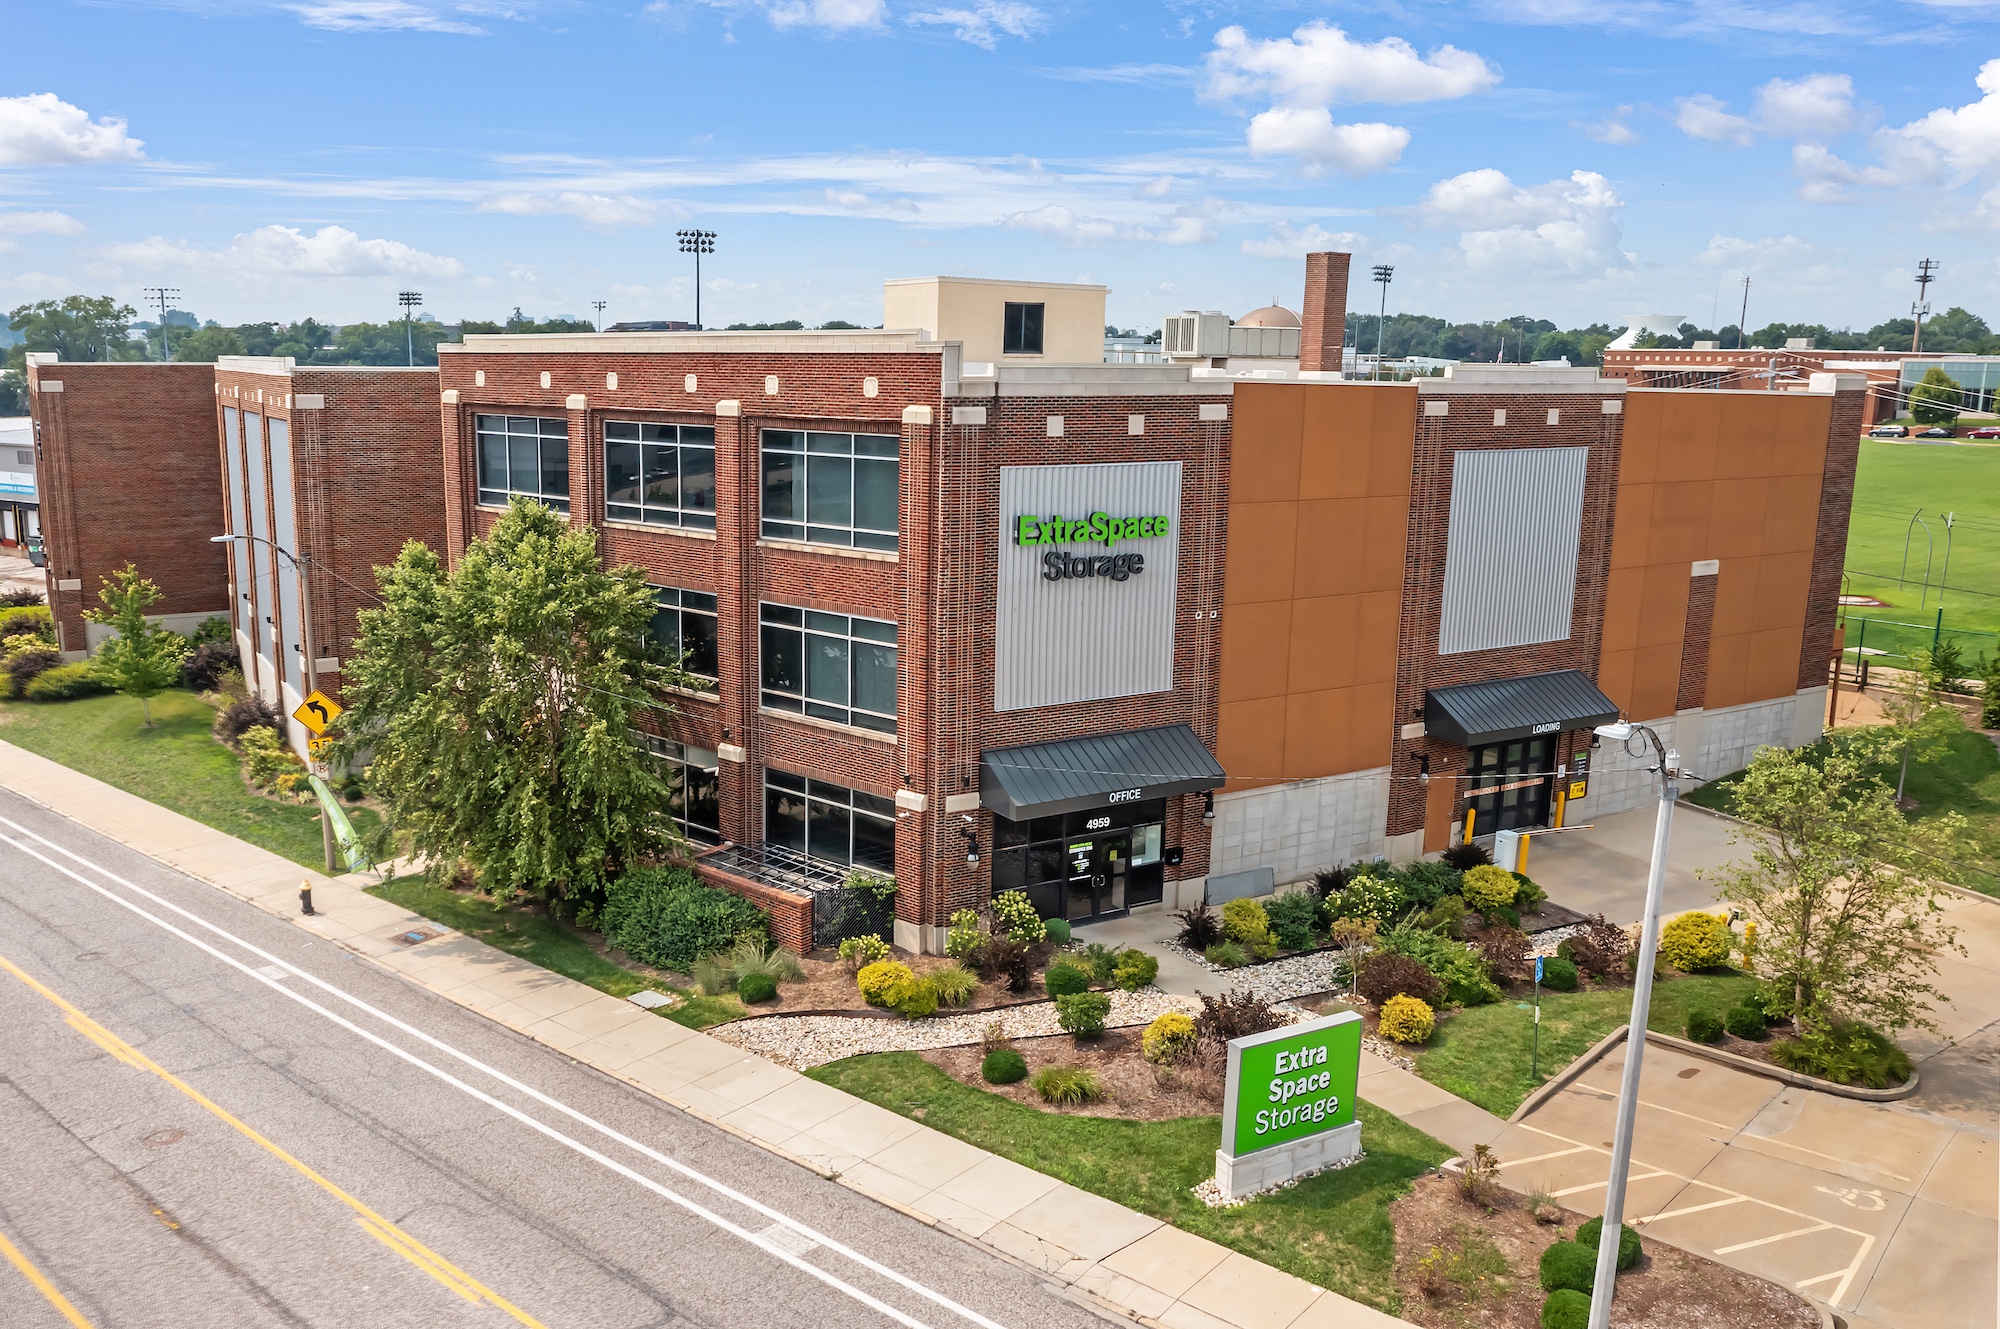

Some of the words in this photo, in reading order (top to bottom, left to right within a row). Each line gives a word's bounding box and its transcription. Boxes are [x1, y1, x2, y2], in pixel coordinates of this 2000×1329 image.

[1043, 551, 1144, 581] Storage
[1532, 722, 1561, 734] LOADING
[1109, 788, 1141, 803] OFFICE
[1086, 816, 1111, 830] 4959
[1275, 1045, 1328, 1076] Extra
[1268, 1070, 1331, 1105] Space
[1254, 1095, 1339, 1136] Storage
